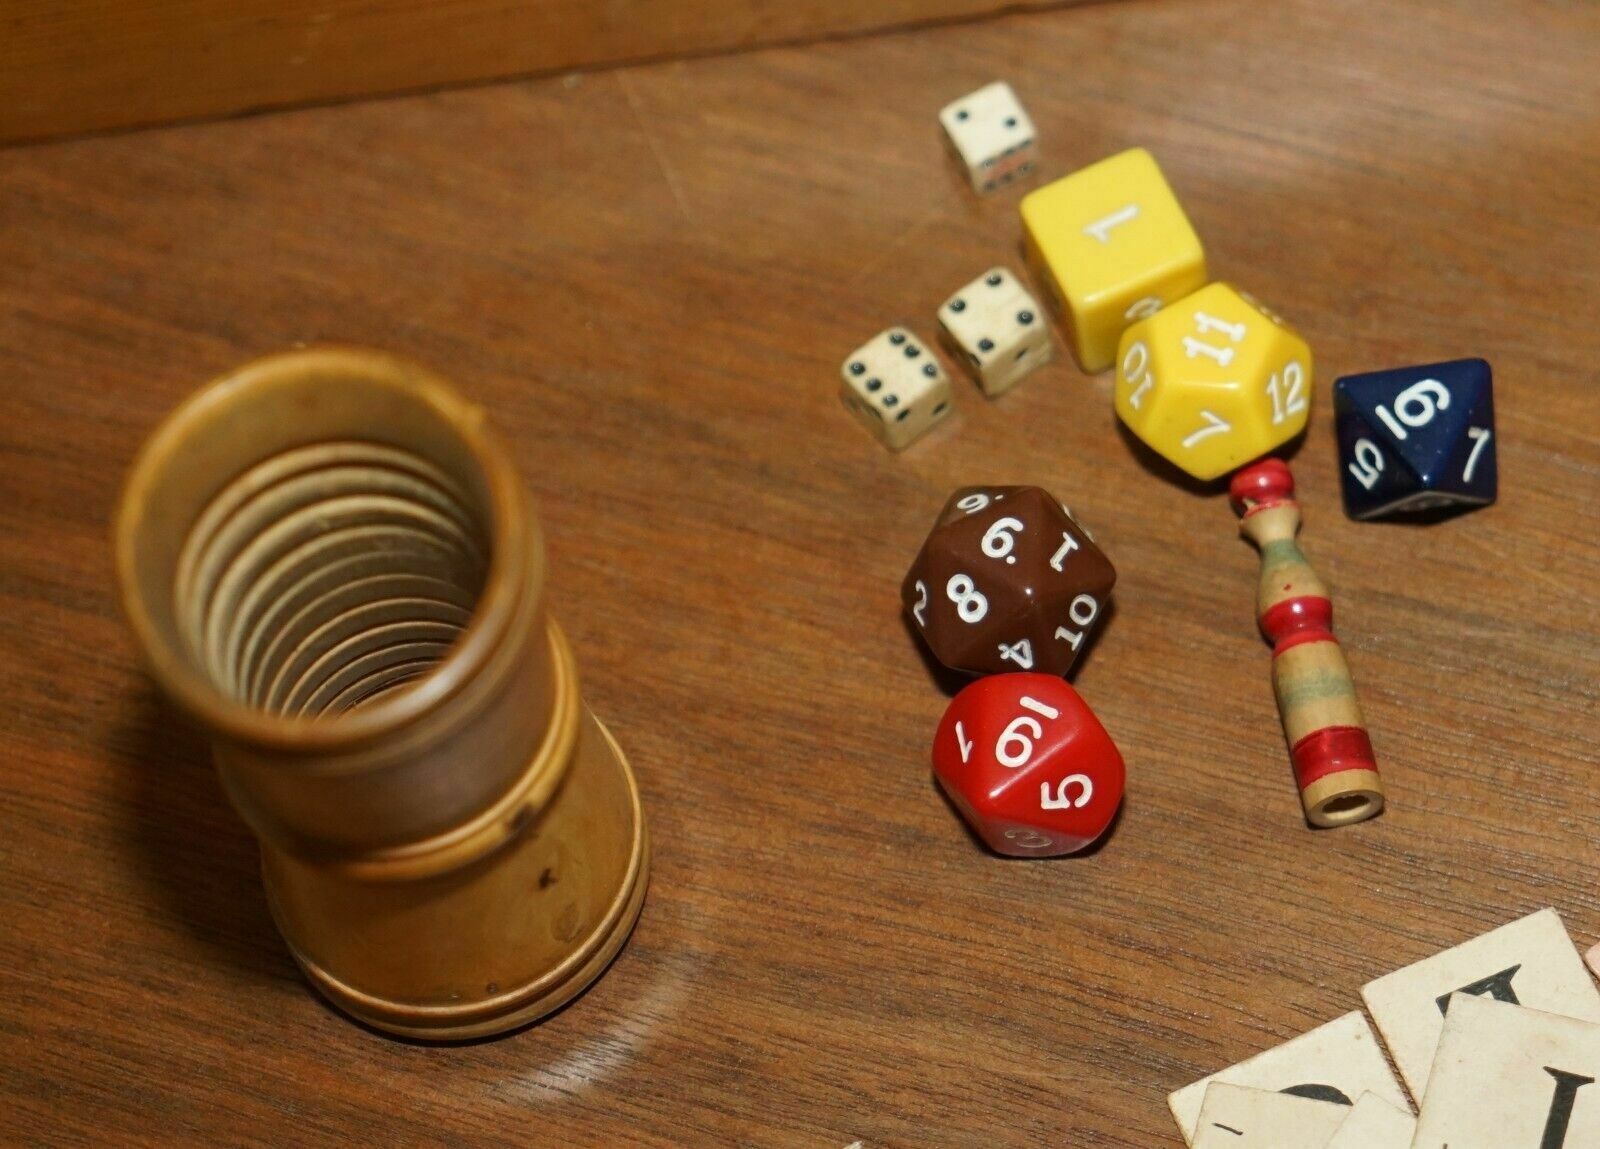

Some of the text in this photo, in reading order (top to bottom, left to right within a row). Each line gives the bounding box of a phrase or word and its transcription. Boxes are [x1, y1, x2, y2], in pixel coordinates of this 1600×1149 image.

[1182, 311, 1246, 367] 11
[1266, 362, 1307, 424] 12
[1181, 410, 1231, 448] 7
[1349, 438, 1384, 490] 5
[1050, 531, 1079, 572] 1
[913, 579, 927, 627] 2
[946, 573, 988, 624] 8
[1054, 594, 1098, 651] 10
[998, 639, 1033, 669] 4
[1041, 773, 1093, 810] 5
